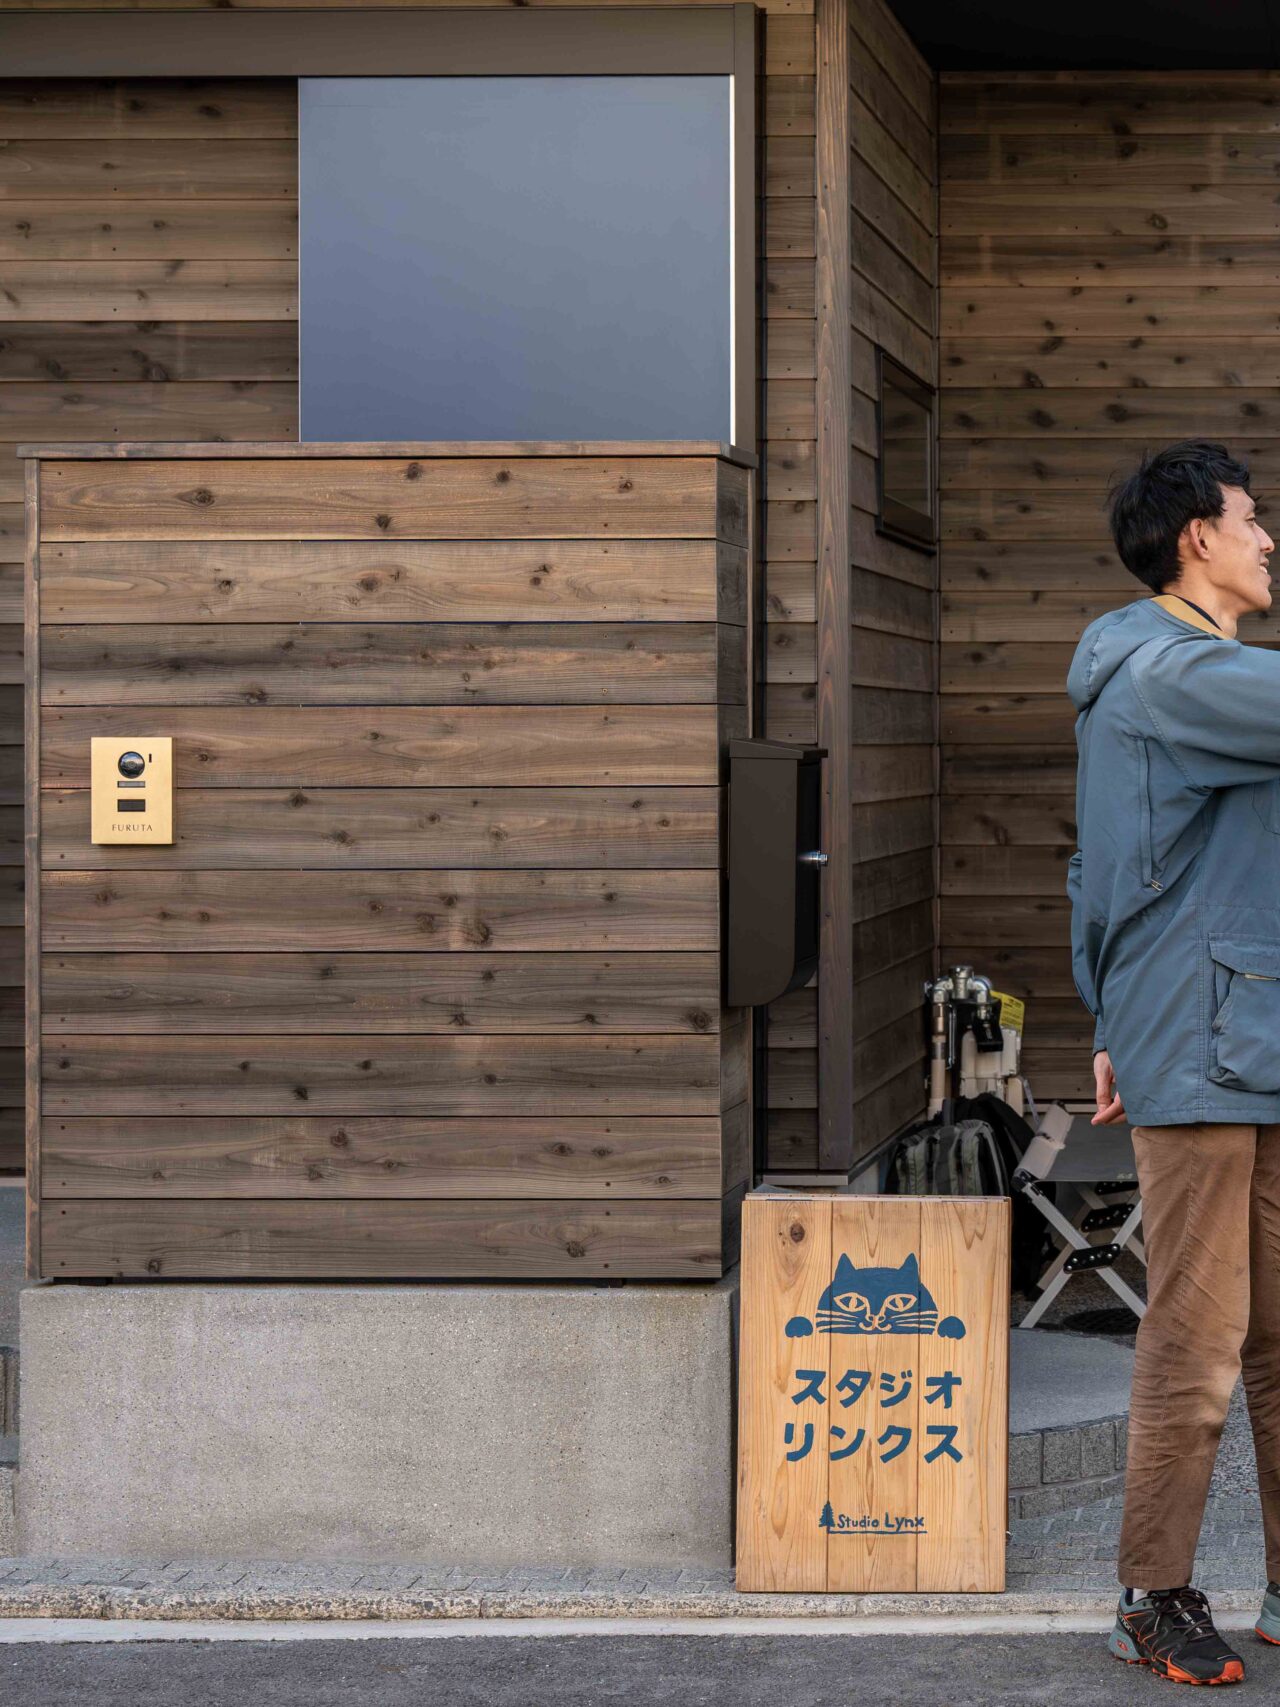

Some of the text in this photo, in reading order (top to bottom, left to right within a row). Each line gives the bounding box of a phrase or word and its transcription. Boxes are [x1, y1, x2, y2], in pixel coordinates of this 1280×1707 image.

[111, 824, 153, 832] FURUTA
[791, 1369, 962, 1409] スタジオ
[784, 1422, 963, 1464] リンクス
[837, 1511, 925, 1532] Studio Lynx
